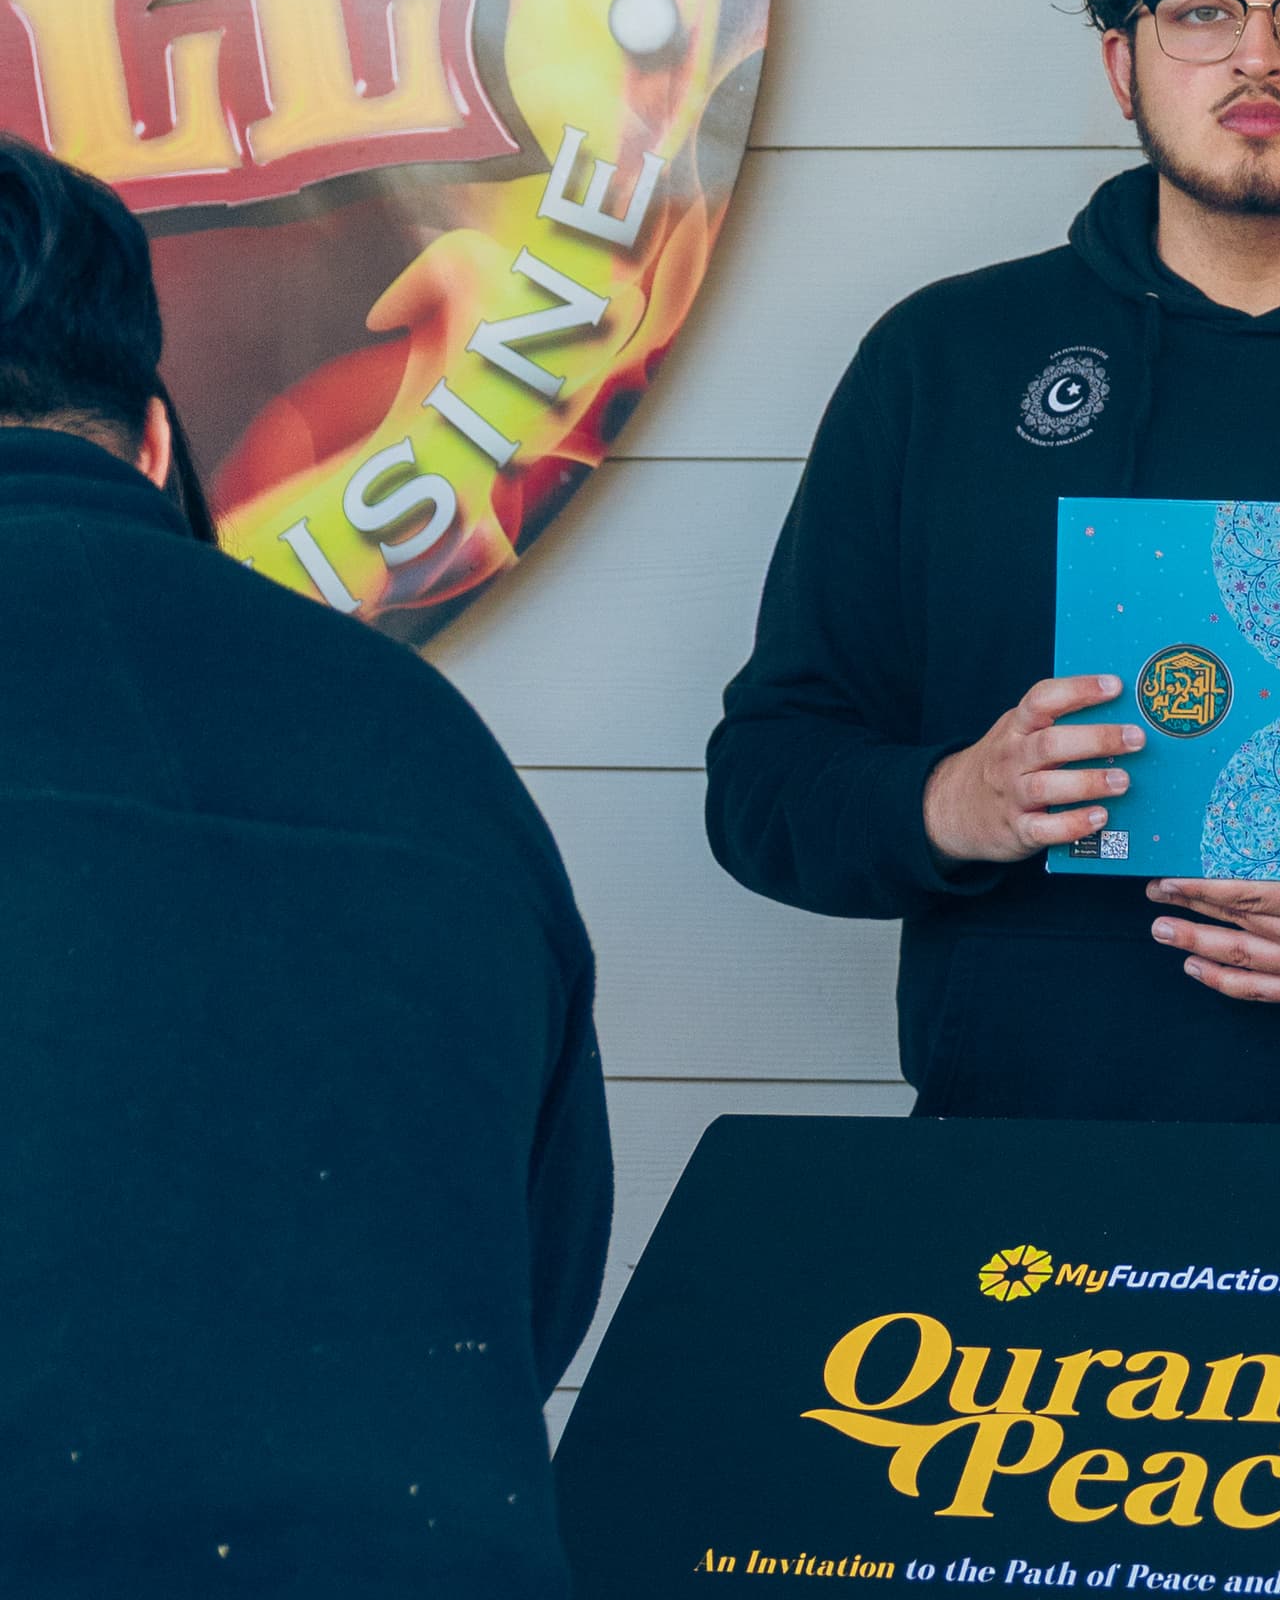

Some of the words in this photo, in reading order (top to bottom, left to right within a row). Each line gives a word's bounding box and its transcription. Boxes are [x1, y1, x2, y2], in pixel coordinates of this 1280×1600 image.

[242, 123, 667, 614] ISINE
[693, 1547, 737, 1575] An
[746, 1549, 896, 1581] Invitation
[906, 1557, 936, 1581] to
[945, 1557, 996, 1584] the
[1003, 1559, 1078, 1587] Path
[1087, 1561, 1121, 1589] of
[1127, 1564, 1217, 1592] Peace
